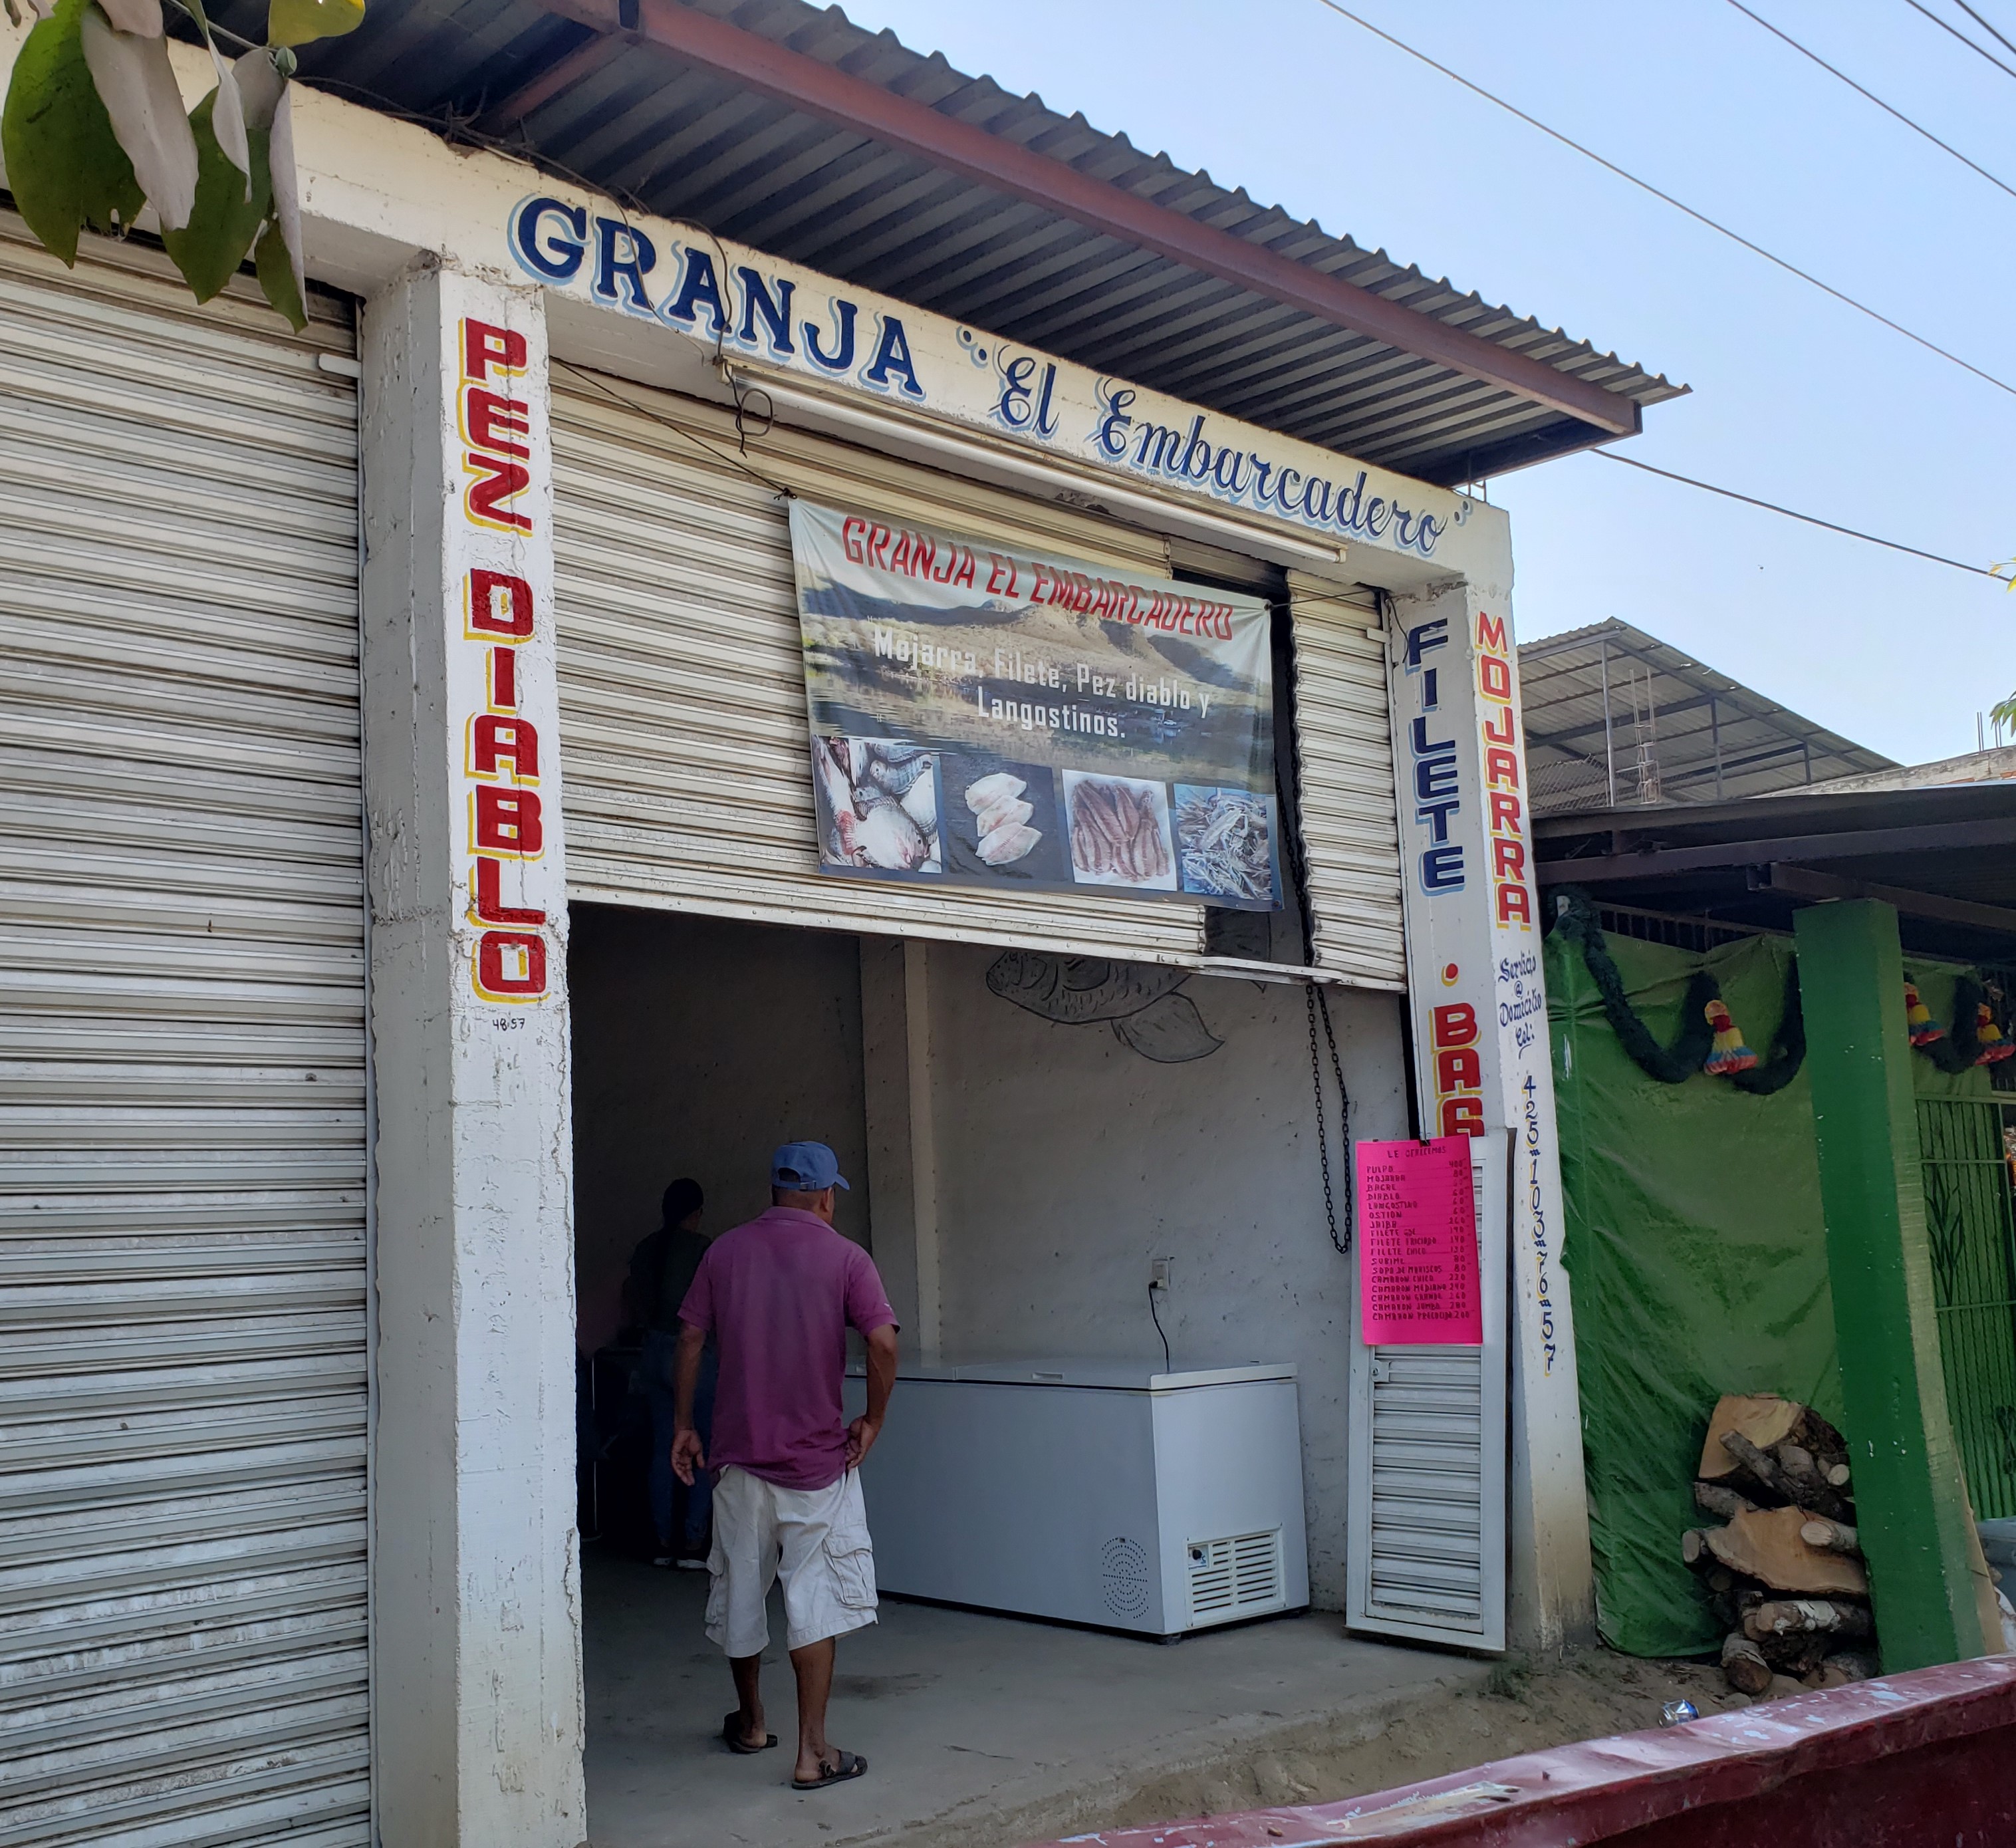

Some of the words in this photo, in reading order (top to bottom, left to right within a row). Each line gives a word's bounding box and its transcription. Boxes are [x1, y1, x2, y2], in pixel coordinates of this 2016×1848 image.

[509, 197, 925, 401] GRANJA
[989, 343, 1059, 438] El
[1085, 377, 1448, 555] Embarcadero
[460, 317, 533, 535] PEZ
[842, 515, 975, 589] GRANJA
[986, 552, 1020, 599] EL
[1029, 562, 1234, 640] EMBARCADERO
[874, 626, 984, 678] Mojarra,
[994, 648, 1067, 693] Filete,
[1076, 663, 1116, 698] Pez
[1125, 673, 1190, 710] diablo
[1199, 693, 1209, 719] y
[977, 686, 1126, 739] Langostinos.
[1406, 617, 1465, 892] FILETE
[1475, 611, 1531, 928] MOJARRA
[467, 568, 547, 999] DIABLO
[1498, 950, 1536, 983] Servicio
[1499, 988, 1542, 1027] Domicilio
[1366, 1165, 1394, 1174] PULPO
[1366, 1184, 1396, 1192] BAGRE
[1366, 1192, 1400, 1201] DIABLO
[1369, 1220, 1397, 1229] JAIBA
[1370, 1238, 1400, 1247] FILETE
[1370, 1248, 1402, 1256] FILETE
[1408, 1265, 1443, 1273] MARISCOS
[1371, 1293, 1411, 1302] CAMARON
[1414, 1283, 1446, 1292] MEDIANO
[1372, 1303, 1412, 1311] CAMARON
